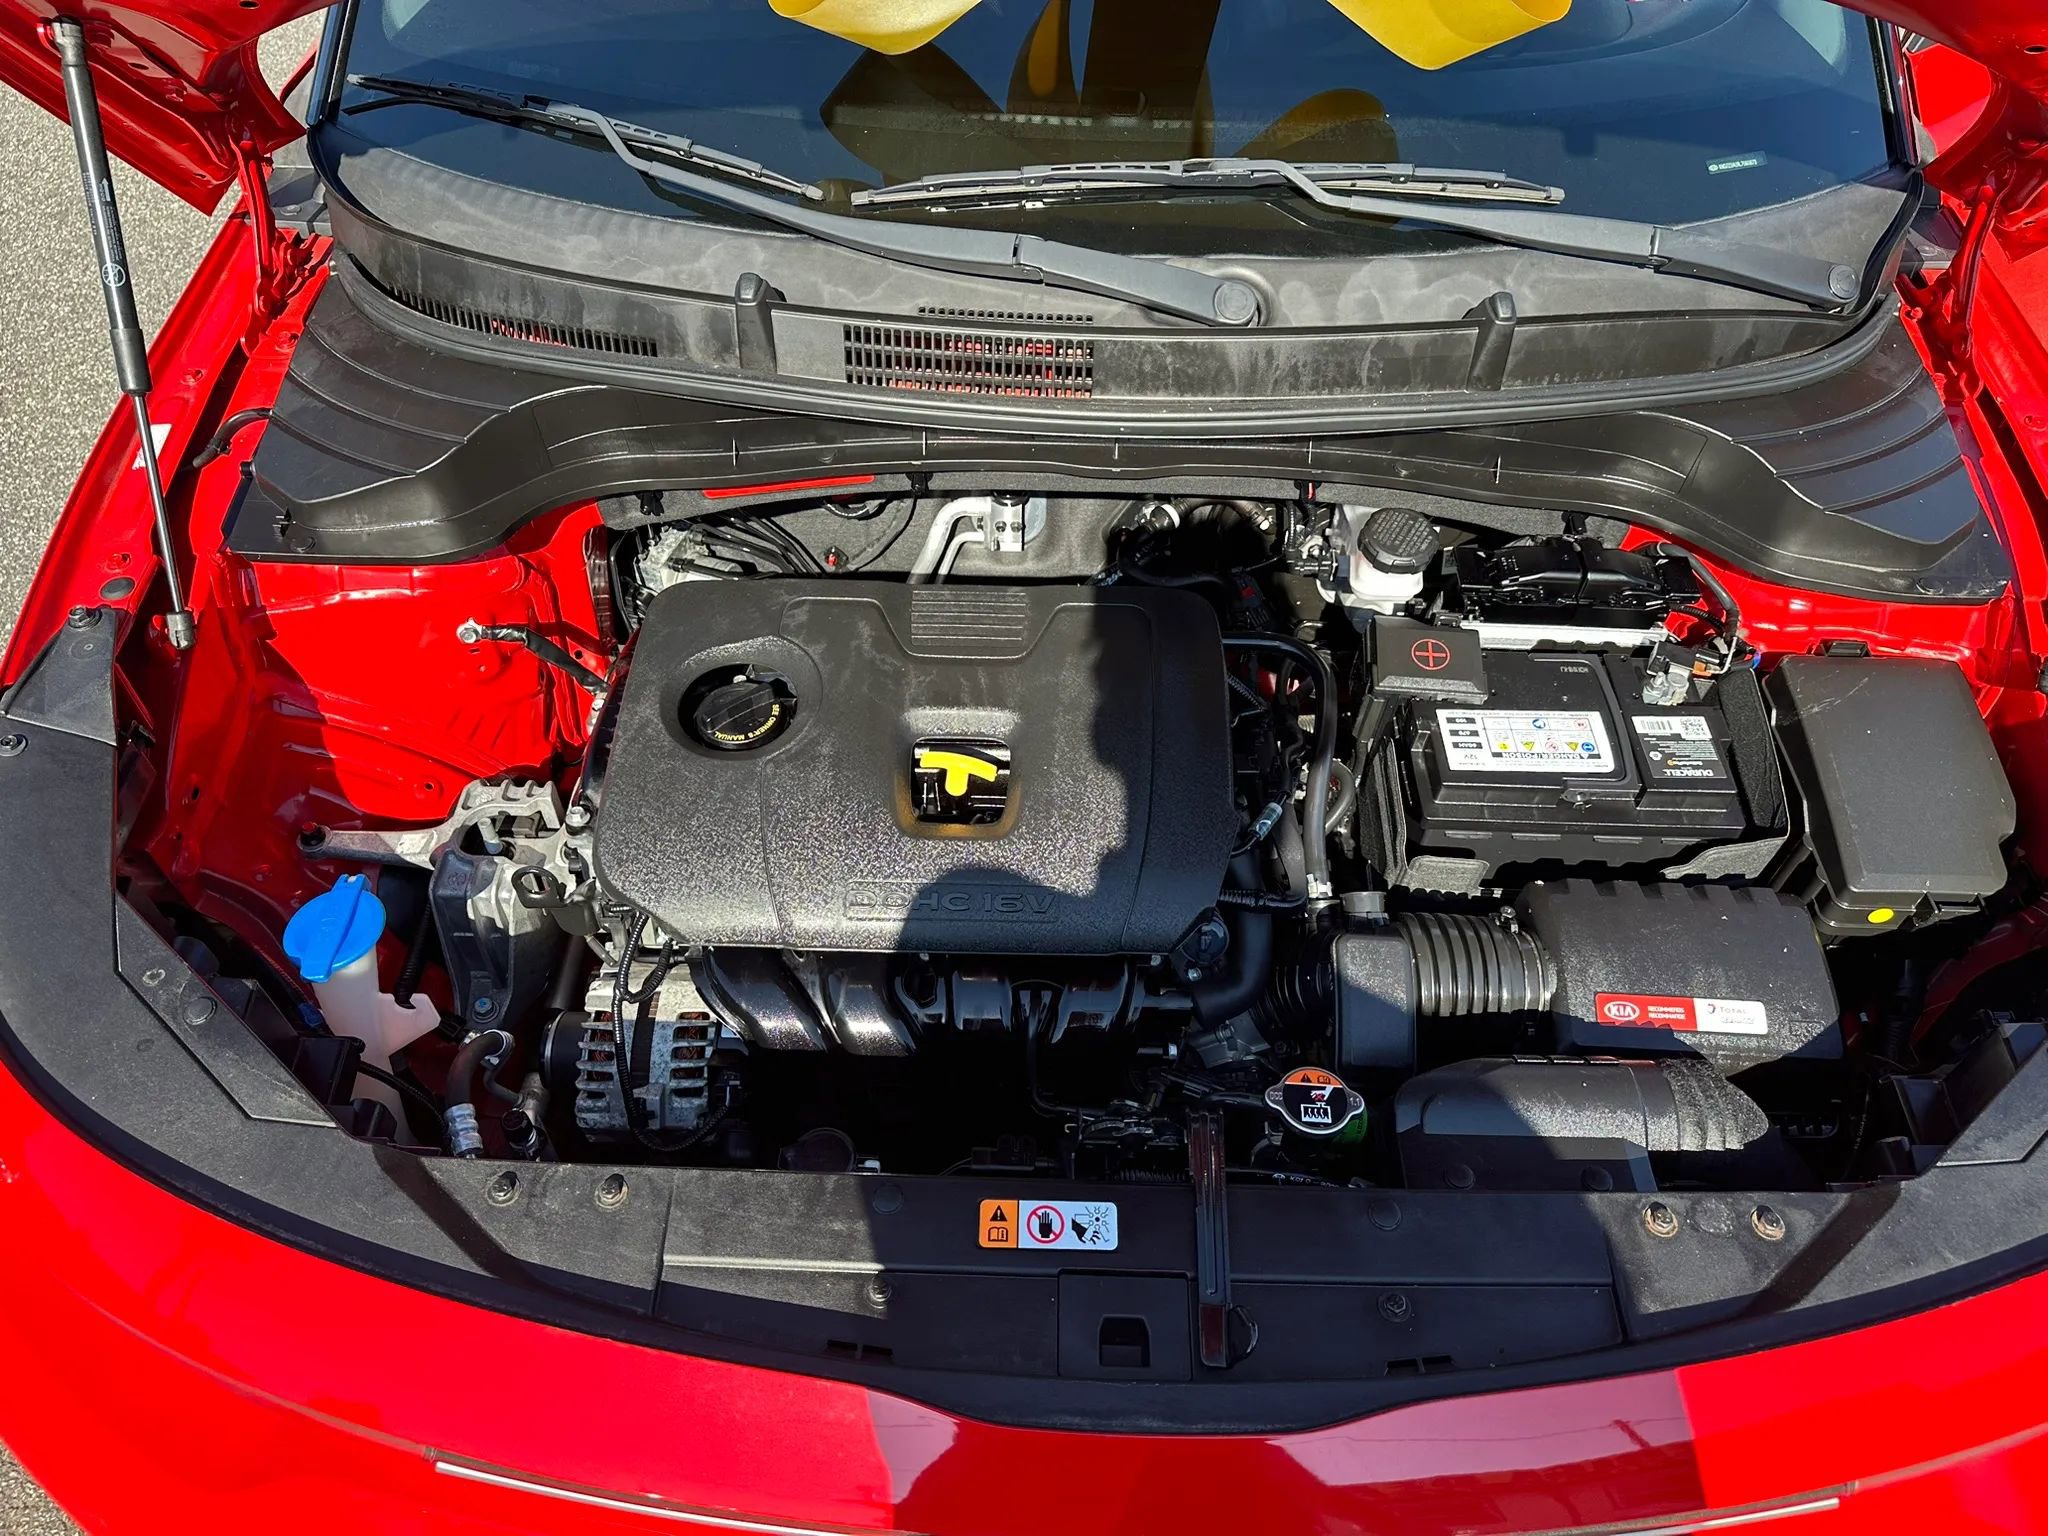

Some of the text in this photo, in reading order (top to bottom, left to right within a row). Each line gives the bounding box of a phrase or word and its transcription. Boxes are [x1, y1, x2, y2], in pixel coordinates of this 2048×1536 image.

[714, 704, 780, 740] SEE OWNER'S MANUAL
[848, 889, 1056, 914] DOHC 16V
[1609, 1005, 1634, 1017] KIA
